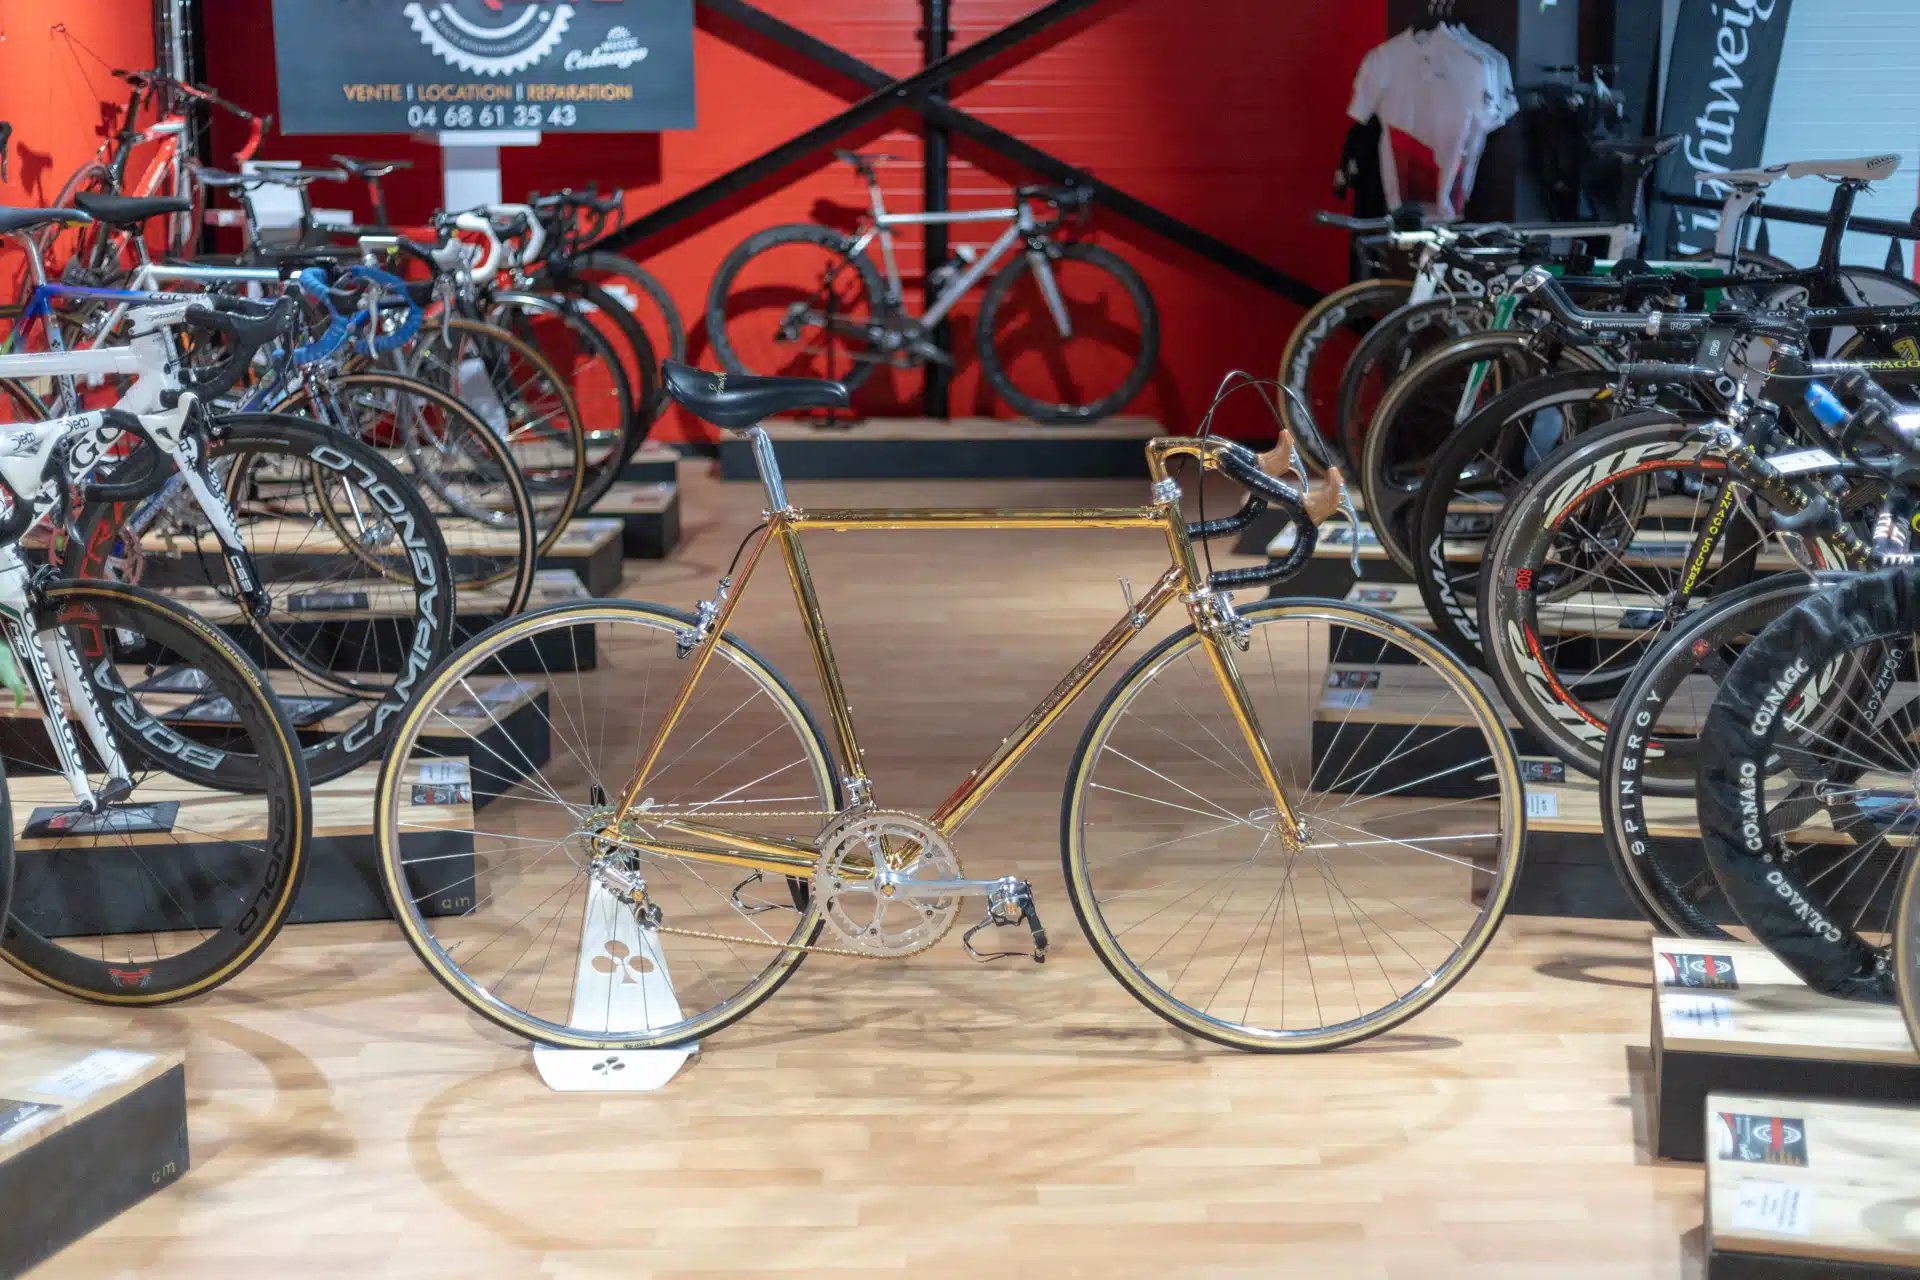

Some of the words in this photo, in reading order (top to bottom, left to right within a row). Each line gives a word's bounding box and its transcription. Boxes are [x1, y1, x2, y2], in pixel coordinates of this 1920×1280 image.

[343, 84, 401, 101] VENTE
[417, 84, 513, 101] LOCATION
[407, 105, 438, 127] 04
[443, 105, 474, 127] 68
[479, 105, 505, 127] 61
[513, 105, 543, 127] 35
[547, 105, 577, 127] 43
[1515, 568, 1533, 590] 808
[1683, 537, 1716, 595] COLUMBUS
[1882, 555, 1915, 565] ITM
[310, 445, 438, 753] CAMPAGNOLO
[93, 657, 226, 771] BORA
[1622, 689, 1662, 857] SPINERGY
[1739, 761, 1764, 852] COLNAGO
[1766, 870, 1843, 943] COLNAGO
